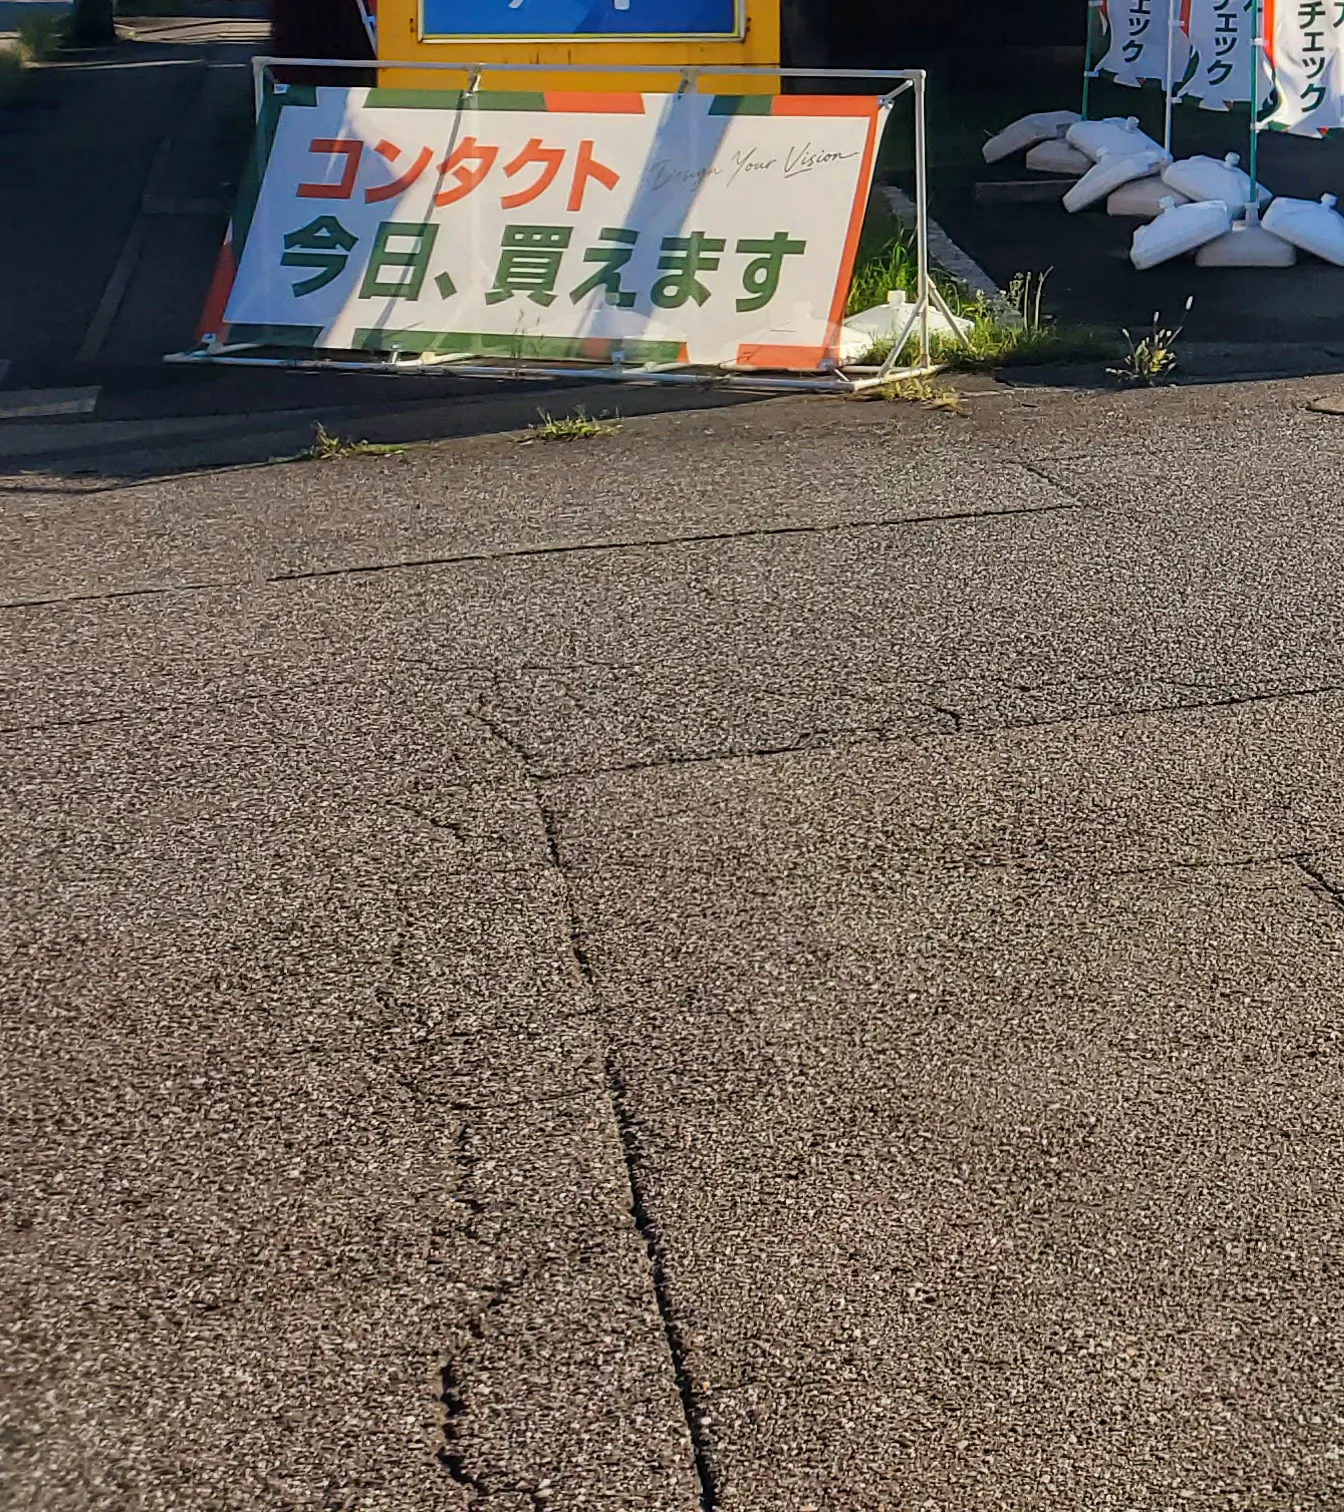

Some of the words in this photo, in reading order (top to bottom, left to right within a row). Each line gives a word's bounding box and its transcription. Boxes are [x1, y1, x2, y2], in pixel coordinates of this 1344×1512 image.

[296, 134, 621, 212] コンタクト
[725, 146, 778, 188] Your
[783, 141, 861, 179] Vision
[278, 214, 807, 314] 今日、買えます
